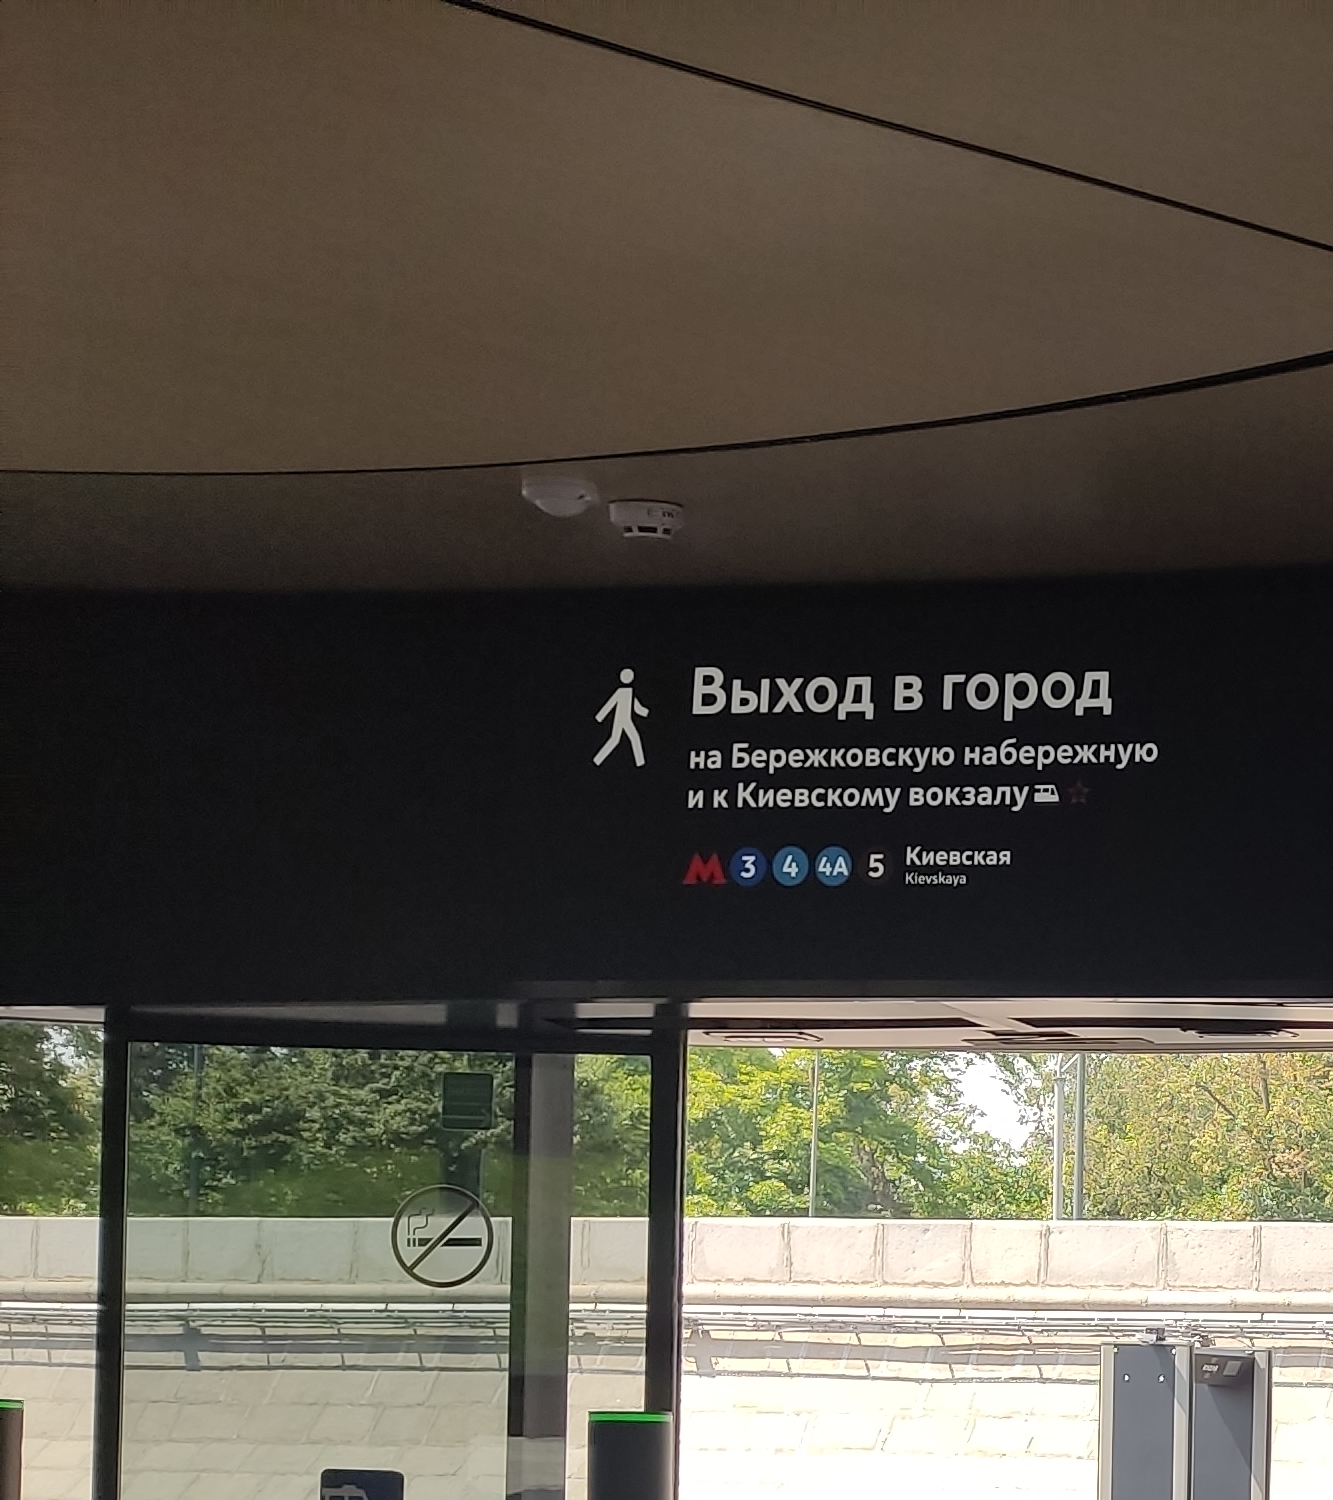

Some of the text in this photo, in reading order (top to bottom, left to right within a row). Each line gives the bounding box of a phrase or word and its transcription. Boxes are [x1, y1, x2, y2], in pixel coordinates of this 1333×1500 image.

[692, 666, 1113, 722] Выход в город
[689, 737, 1159, 775] на Бережковскую набережную
[687, 782, 1029, 813] и к Киевскому вокзалу
[740, 855, 756, 878] 3
[782, 854, 799, 878] 4
[818, 856, 849, 877] 4А
[868, 853, 885, 878] 5
[905, 845, 1011, 866] Киевская
[905, 871, 967, 887] Kievskaya
